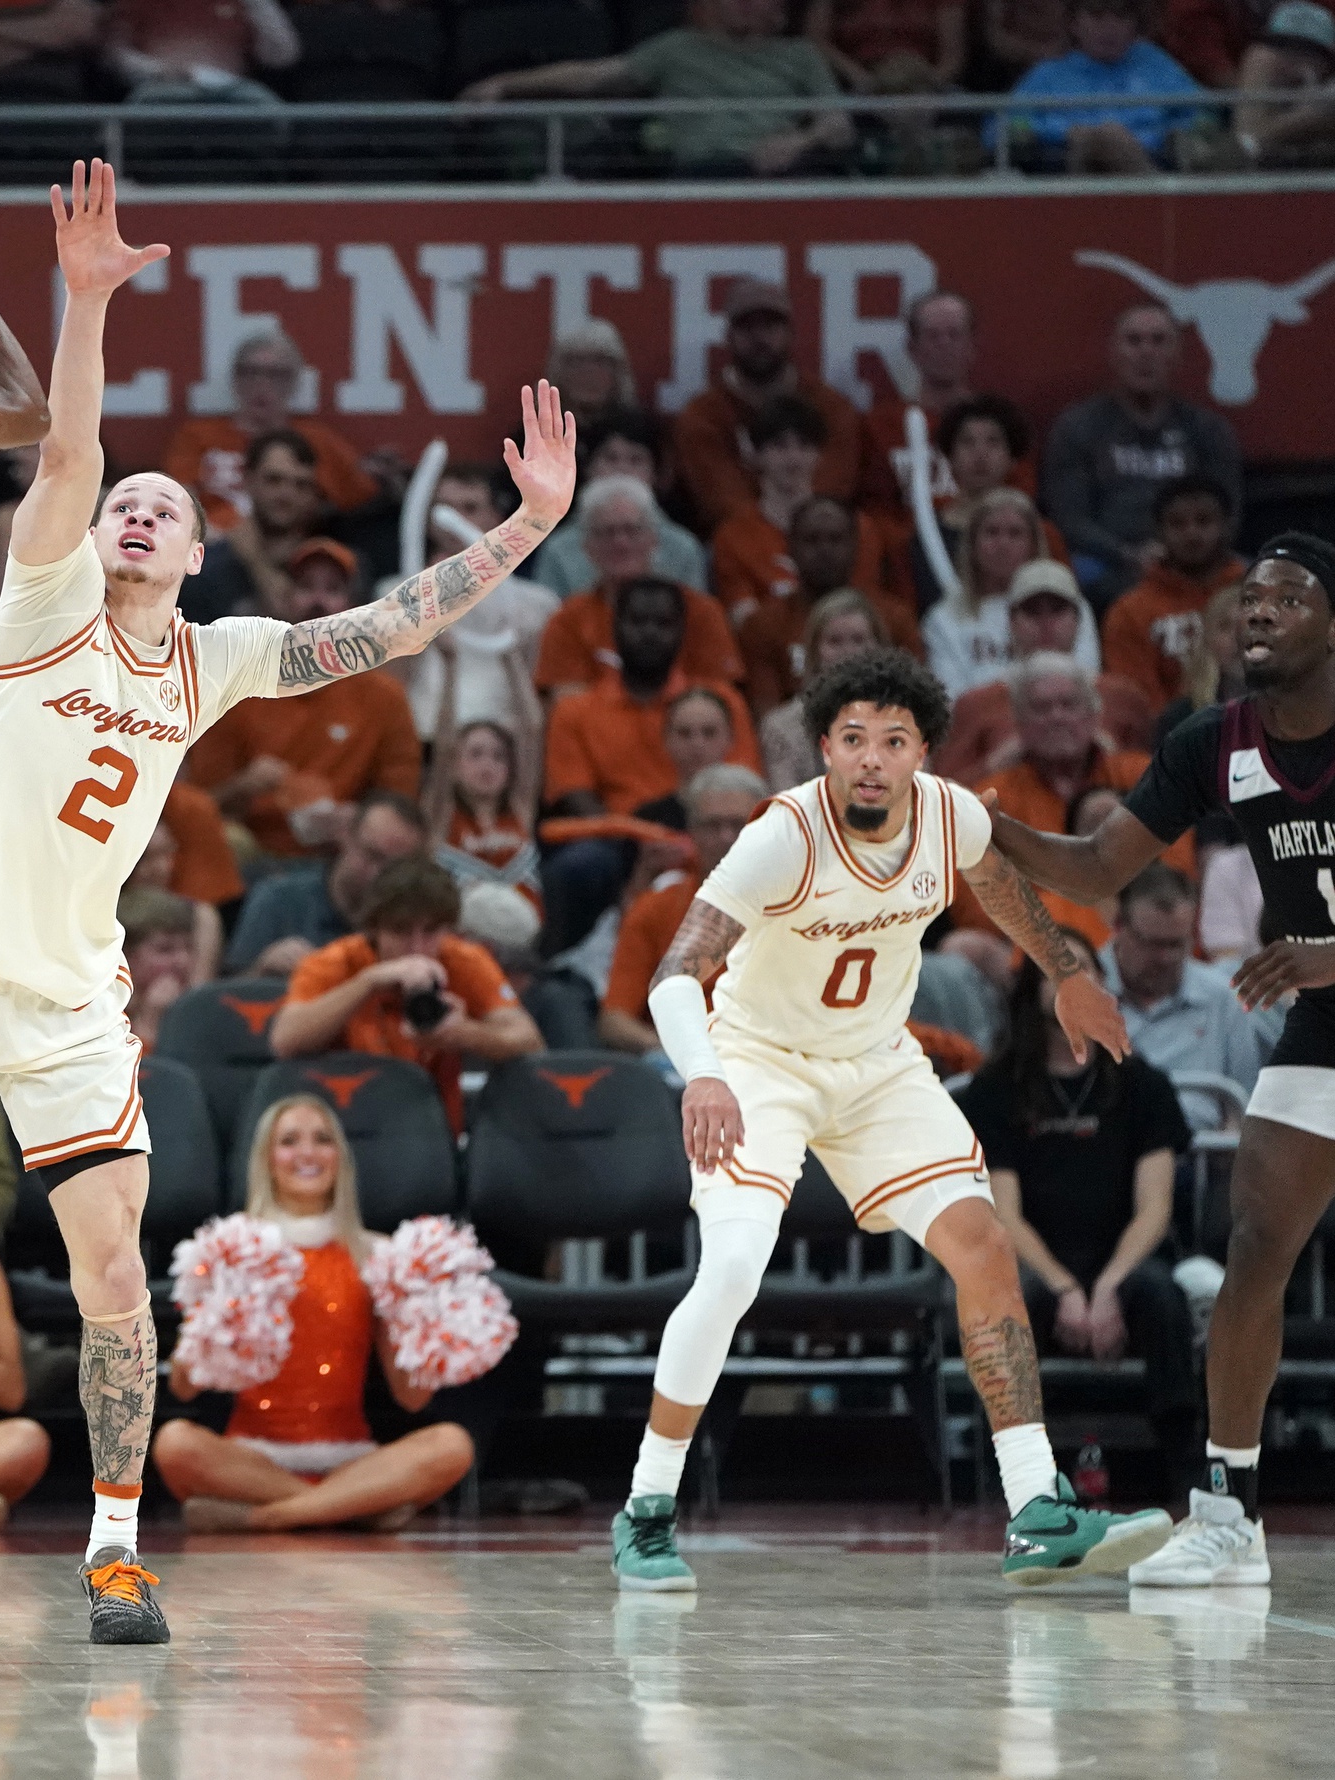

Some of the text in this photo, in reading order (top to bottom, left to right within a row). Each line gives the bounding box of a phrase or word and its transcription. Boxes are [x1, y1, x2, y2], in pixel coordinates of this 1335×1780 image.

[318, 636, 381, 675] GOD
[42, 688, 187, 743] Longhorns
[58, 745, 139, 844] 2
[1268, 820, 1335, 861] MARYLA
[913, 871, 936, 899] SEC
[791, 901, 940, 942] Longhorns
[821, 948, 877, 1008] 0
[85, 1344, 132, 1362] POSITIVE
